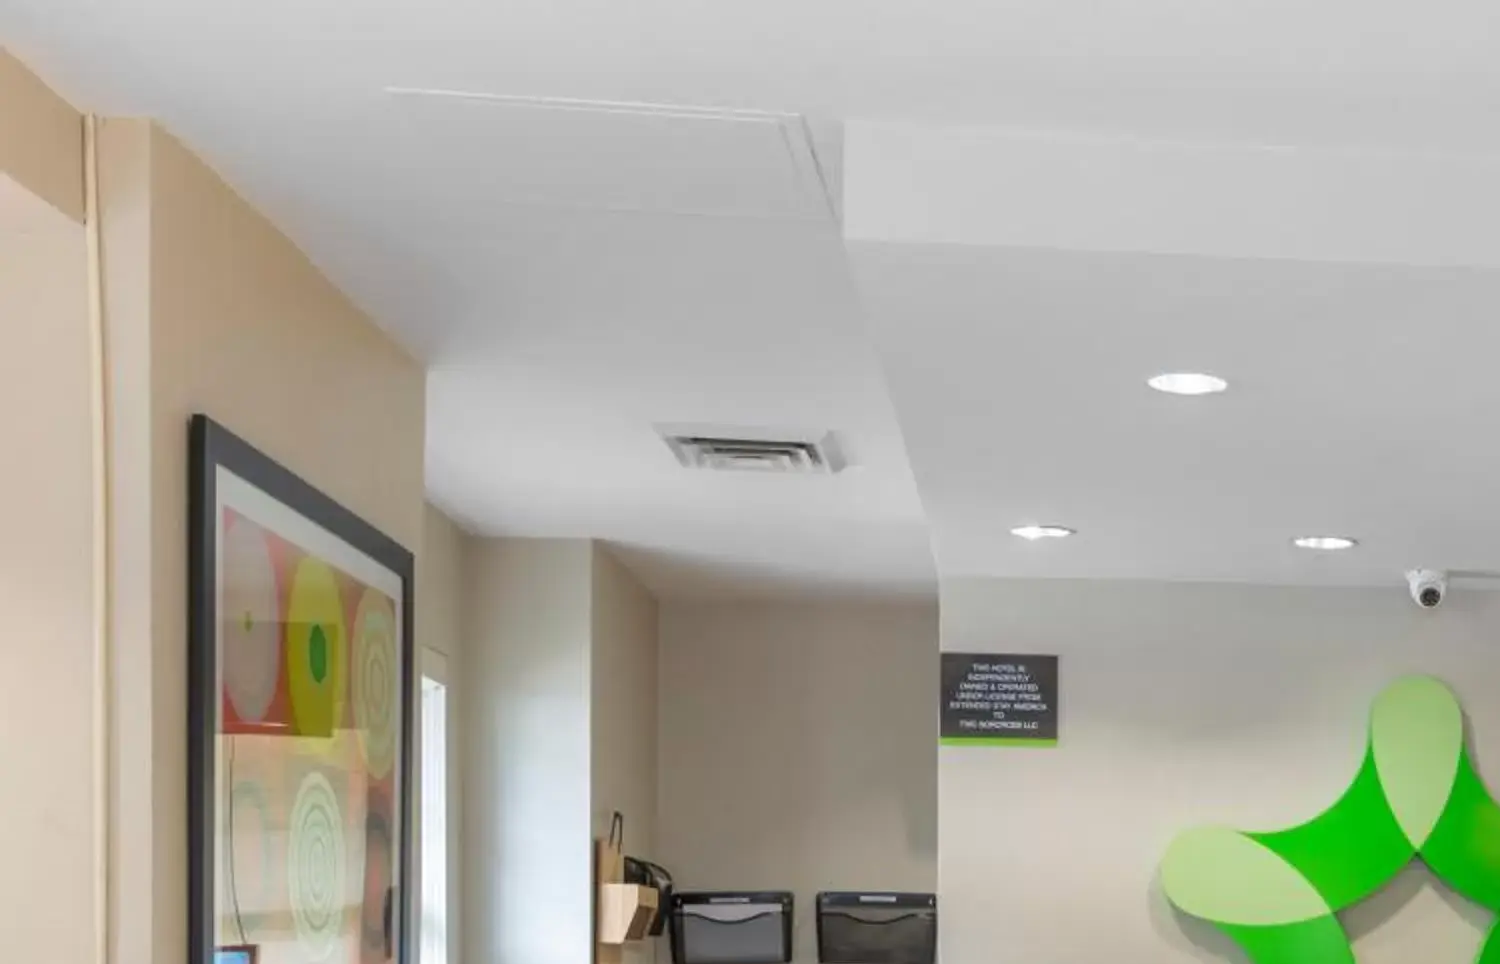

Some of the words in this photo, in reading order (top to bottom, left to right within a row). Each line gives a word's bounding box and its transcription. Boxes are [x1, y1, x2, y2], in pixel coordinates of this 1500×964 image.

[991, 664, 1015, 674] HOTEL
[959, 683, 989, 691] OWNED
[997, 683, 1039, 692] OPERATED
[1018, 693, 1041, 701] FROM
[949, 701, 991, 710] EXTENDED
[1013, 703, 1048, 711] AMERICA
[993, 711, 1005, 719] TO
[1023, 721, 1039, 729] LLC
